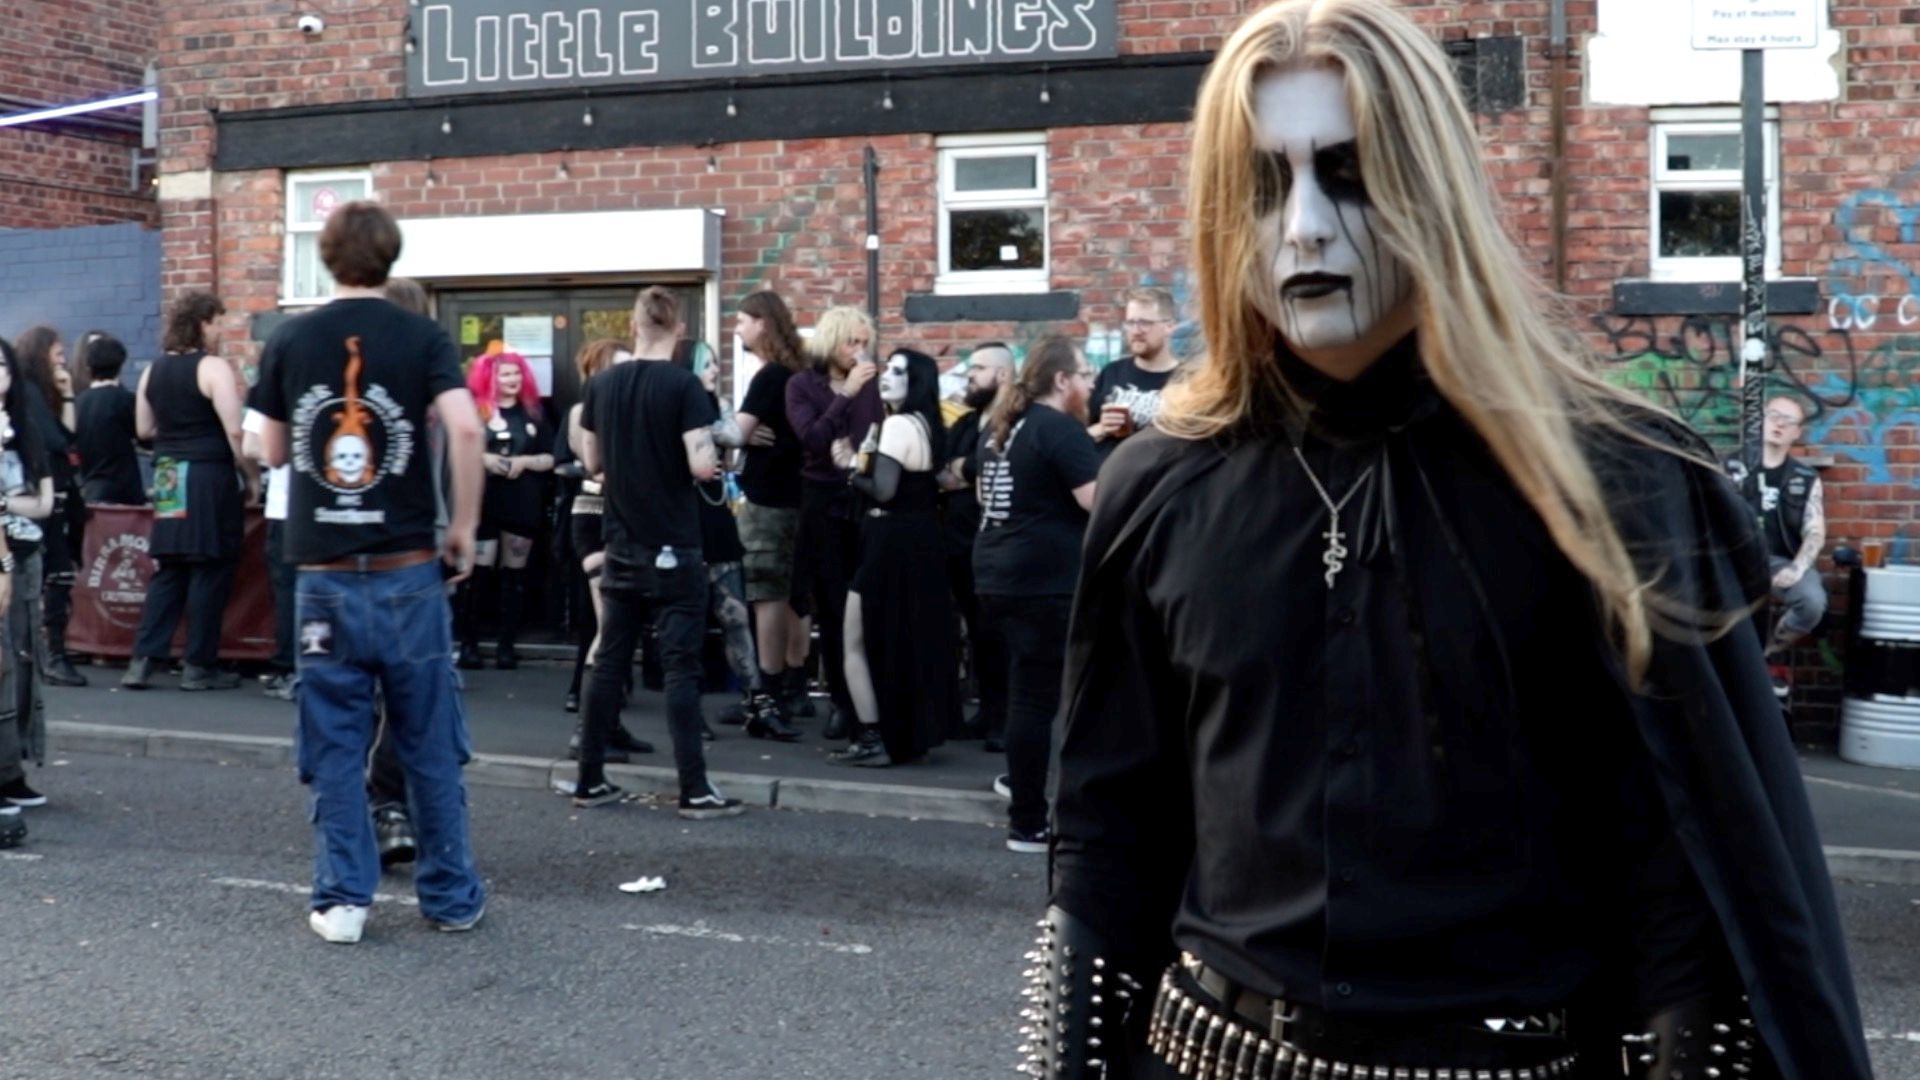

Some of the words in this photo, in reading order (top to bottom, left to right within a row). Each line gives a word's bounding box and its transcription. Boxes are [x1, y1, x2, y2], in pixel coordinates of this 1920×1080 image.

[1712, 9, 1732, 19] Pay
[1750, 9, 1796, 18] machine
[691, 0, 1097, 67] BUILDINGS
[1706, 35, 1729, 43] Max
[1733, 35, 1756, 44] stay
[1770, 35, 1802, 43] hours
